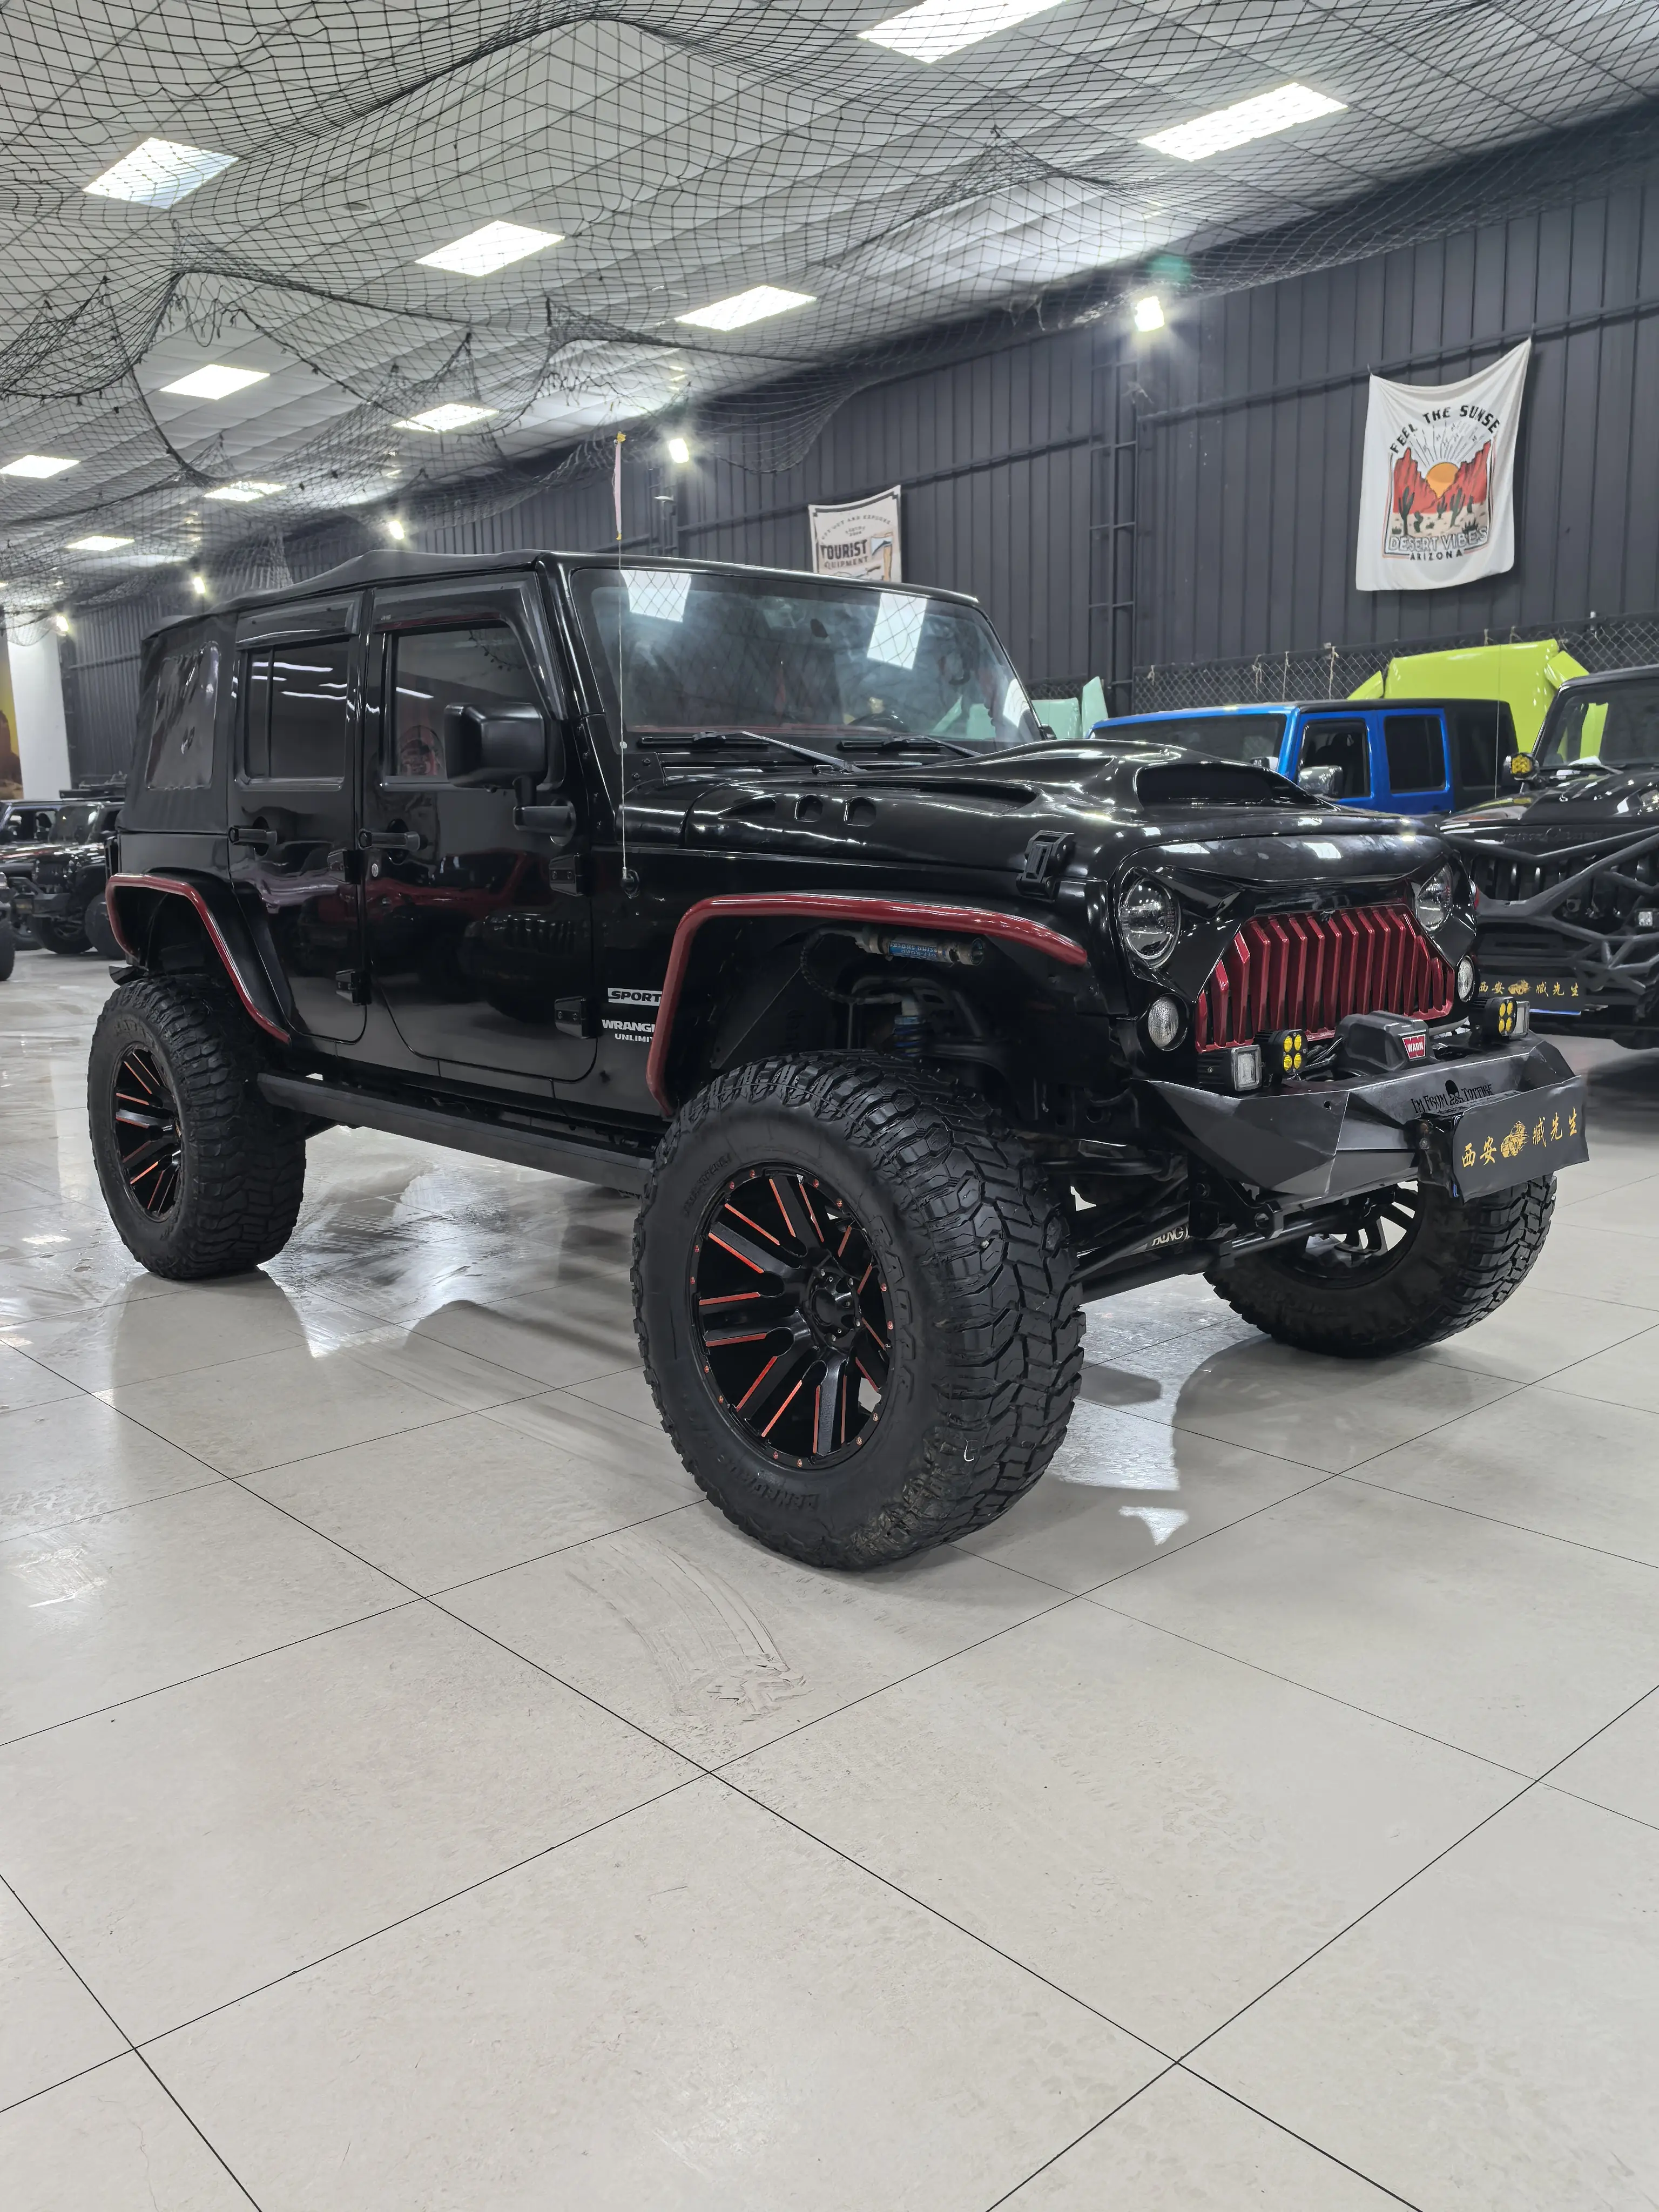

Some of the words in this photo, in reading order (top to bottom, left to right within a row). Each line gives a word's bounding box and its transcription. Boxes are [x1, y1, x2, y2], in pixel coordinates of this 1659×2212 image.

[1390, 423, 1418, 454] FEEL
[1422, 407, 1451, 424] THE
[1389, 535, 1439, 552] DESERT
[1441, 526, 1488, 550] VIBES
[820, 539, 867, 559] TOURIST
[1410, 549, 1463, 561] ARIZONA
[611, 990, 662, 1002] SPORT
[1407, 1042, 1424, 1052] WARN
[1422, 1094, 1449, 1110] FROM
[1462, 1136, 1496, 1168] 西安
